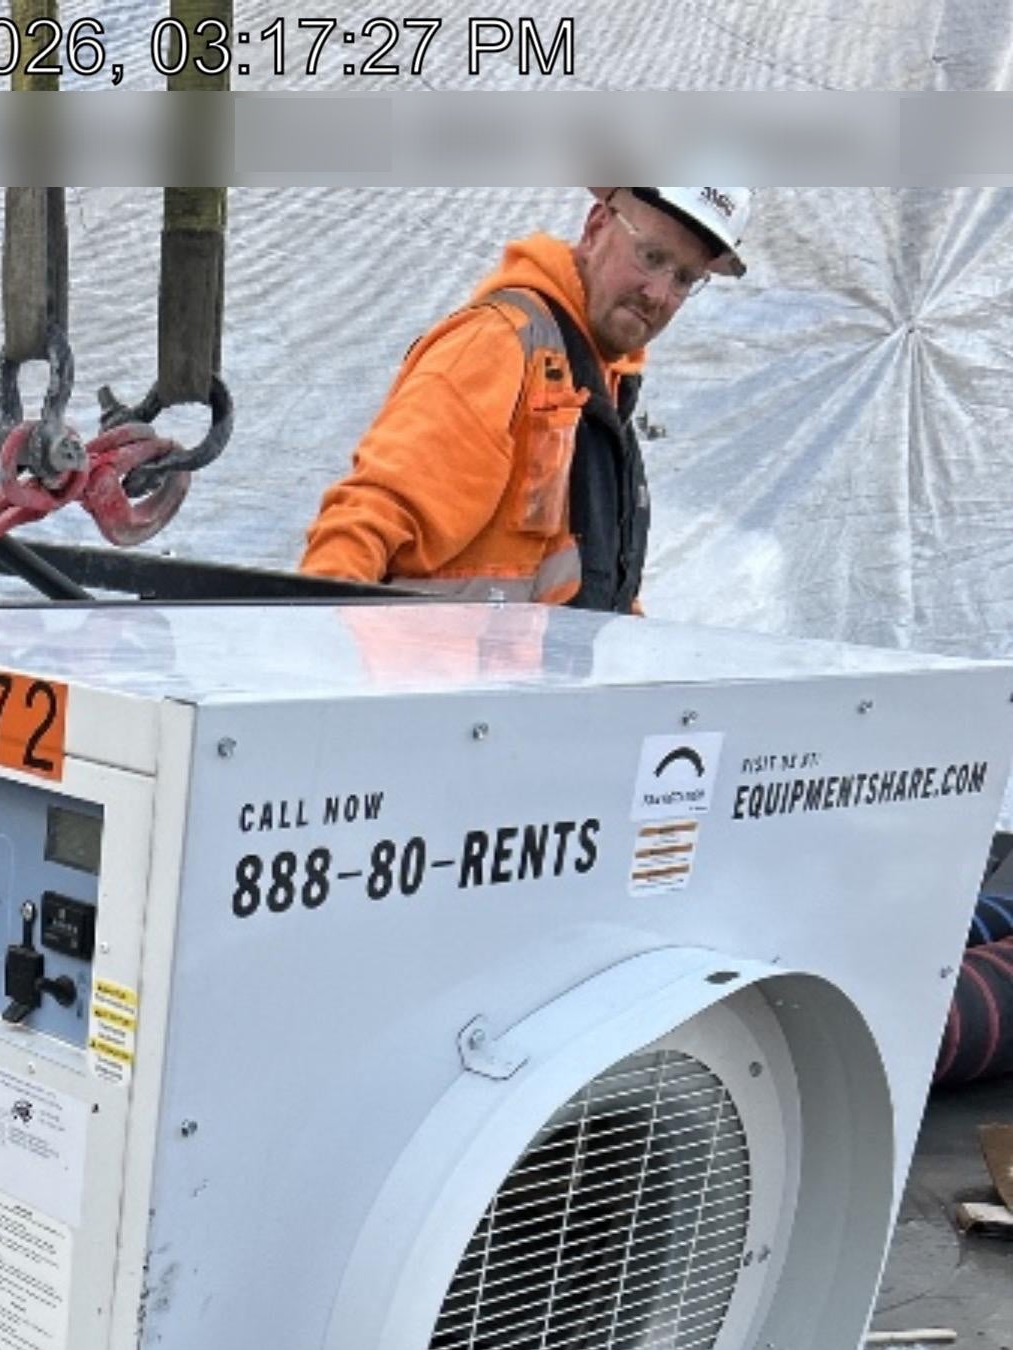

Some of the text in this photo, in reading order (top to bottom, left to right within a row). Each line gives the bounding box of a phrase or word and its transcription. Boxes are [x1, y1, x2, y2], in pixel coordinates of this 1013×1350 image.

[238, 791, 384, 832] CALL NOW
[731, 761, 987, 820] EQUIPMENTSHARE.COM
[232, 818, 600, 918] 888-80-RENTS
